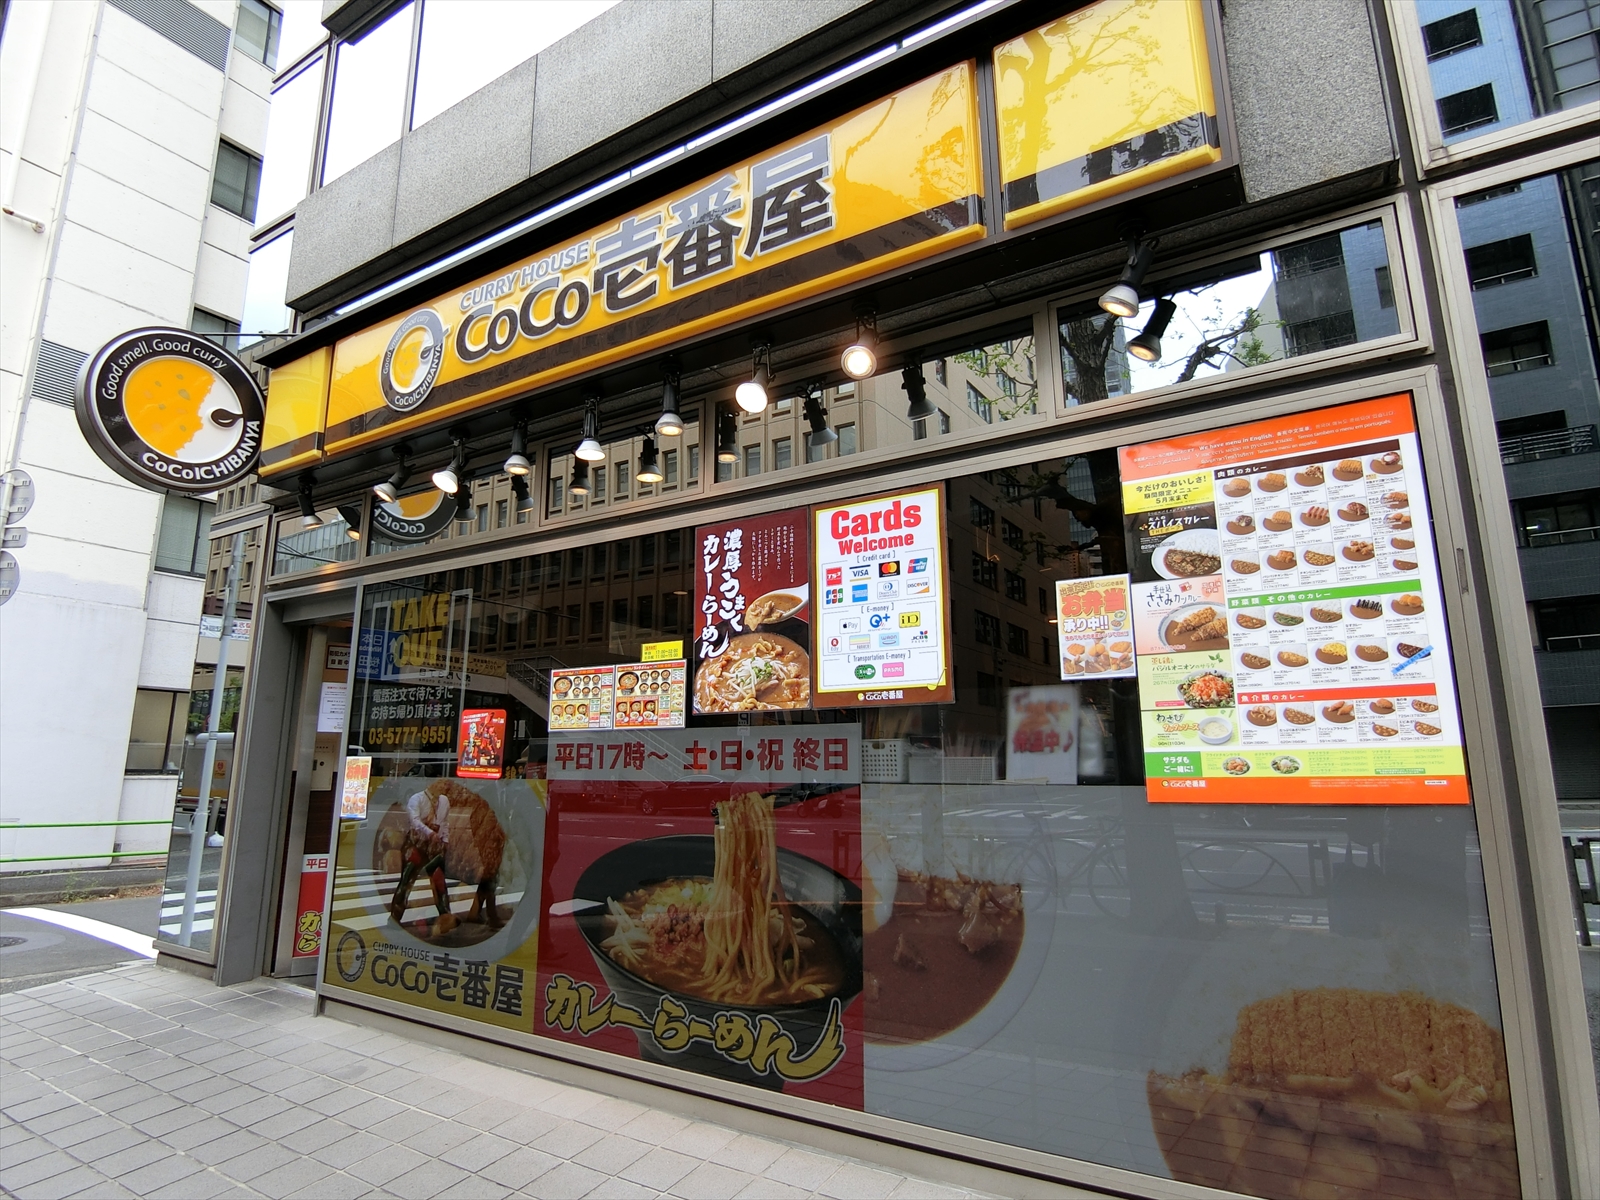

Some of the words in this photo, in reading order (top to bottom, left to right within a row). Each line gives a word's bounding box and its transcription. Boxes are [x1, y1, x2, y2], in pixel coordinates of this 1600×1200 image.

[456, 134, 835, 363] CoCo壱番屋
[460, 271, 517, 312] CURRY
[521, 240, 589, 284] HOUSE
[102, 362, 123, 400] Good
[118, 344, 153, 370] smell.
[152, 338, 191, 353] Good
[192, 343, 229, 370] curry
[395, 342, 443, 406] CoCoICHIBANYA
[142, 419, 261, 481] CoCoICHIBANYA
[1209, 442, 1224, 450] have
[1250, 433, 1274, 442] English.
[1217, 465, 1267, 479] 肉類のカレー
[1135, 475, 1207, 492] 今だけのおいしさ!
[1144, 487, 1200, 499] 期間限定メニュー
[1156, 494, 1189, 504] 5月末まで
[831, 500, 922, 540] Cards
[1148, 516, 1210, 530] スパイスカレー
[838, 533, 914, 556] Welcome
[863, 554, 878, 562] Credit
[852, 569, 869, 577] VISA
[699, 534, 731, 659] カレーらーめん
[1061, 588, 1126, 617] お弁当
[1146, 592, 1202, 607] ささみカツカレー
[1267, 592, 1332, 604] その他のカレー
[391, 592, 450, 631] TAKE
[866, 604, 889, 613] E-money
[848, 621, 858, 629] Pay
[901, 614, 919, 624] iD
[393, 630, 444, 667] OUT
[853, 654, 884, 663] Transportation
[886, 652, 906, 660] E-money
[373, 685, 453, 703] 電話注文で待たずに
[1240, 694, 1305, 702] 魚介類のカレー
[371, 703, 456, 721] お持ち帰り頂けます。
[1156, 713, 1185, 723] わさび
[368, 726, 452, 745] 03-5777-9551
[683, 738, 784, 772] 土・日・祝
[792, 737, 849, 772] 終日
[1162, 756, 1190, 764] サラダも
[1163, 765, 1194, 773] ご一緒に!
[306, 858, 328, 869] 平日
[372, 941, 400, 956] CURRY
[400, 947, 430, 961] HOUSE
[371, 952, 525, 1017] CoCo壱番屋
[545, 974, 847, 1082] カレーらーめん
